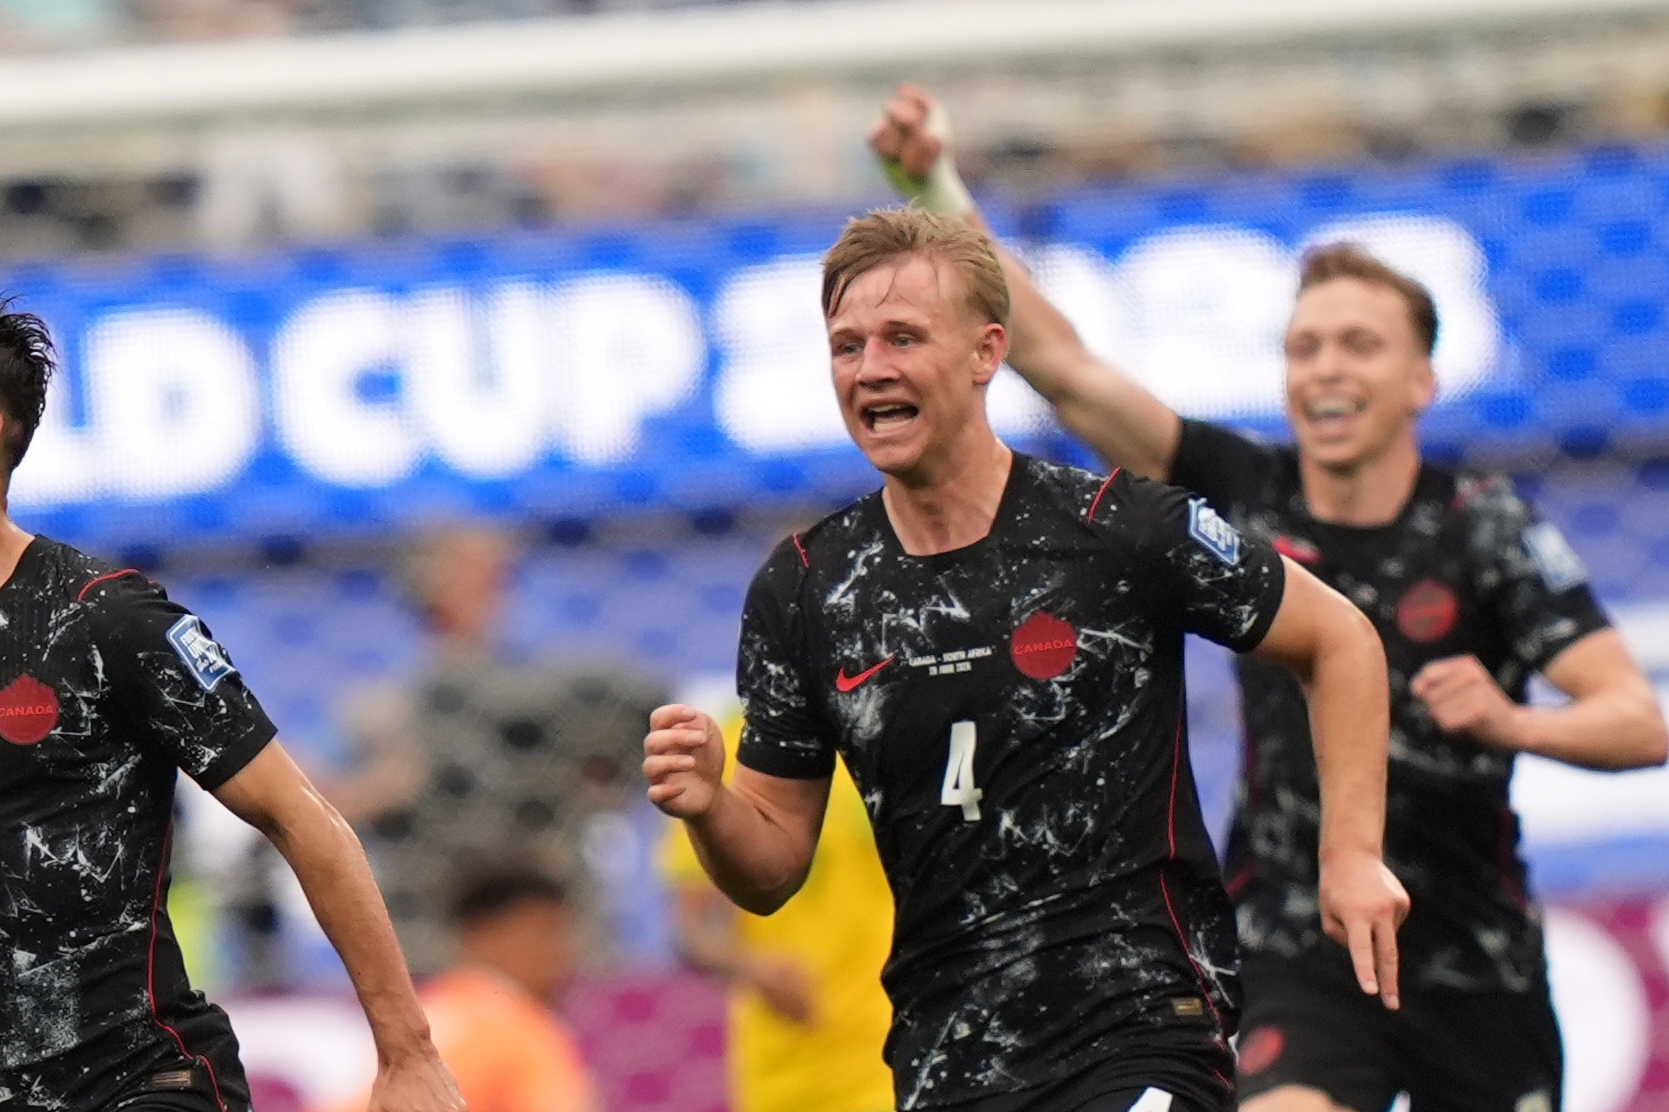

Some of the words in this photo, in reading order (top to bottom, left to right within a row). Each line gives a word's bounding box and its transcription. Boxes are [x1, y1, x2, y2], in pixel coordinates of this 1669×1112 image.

[271, 273, 705, 488] CUP
[1013, 639, 1073, 656] CANADA
[941, 720, 984, 822] 4
